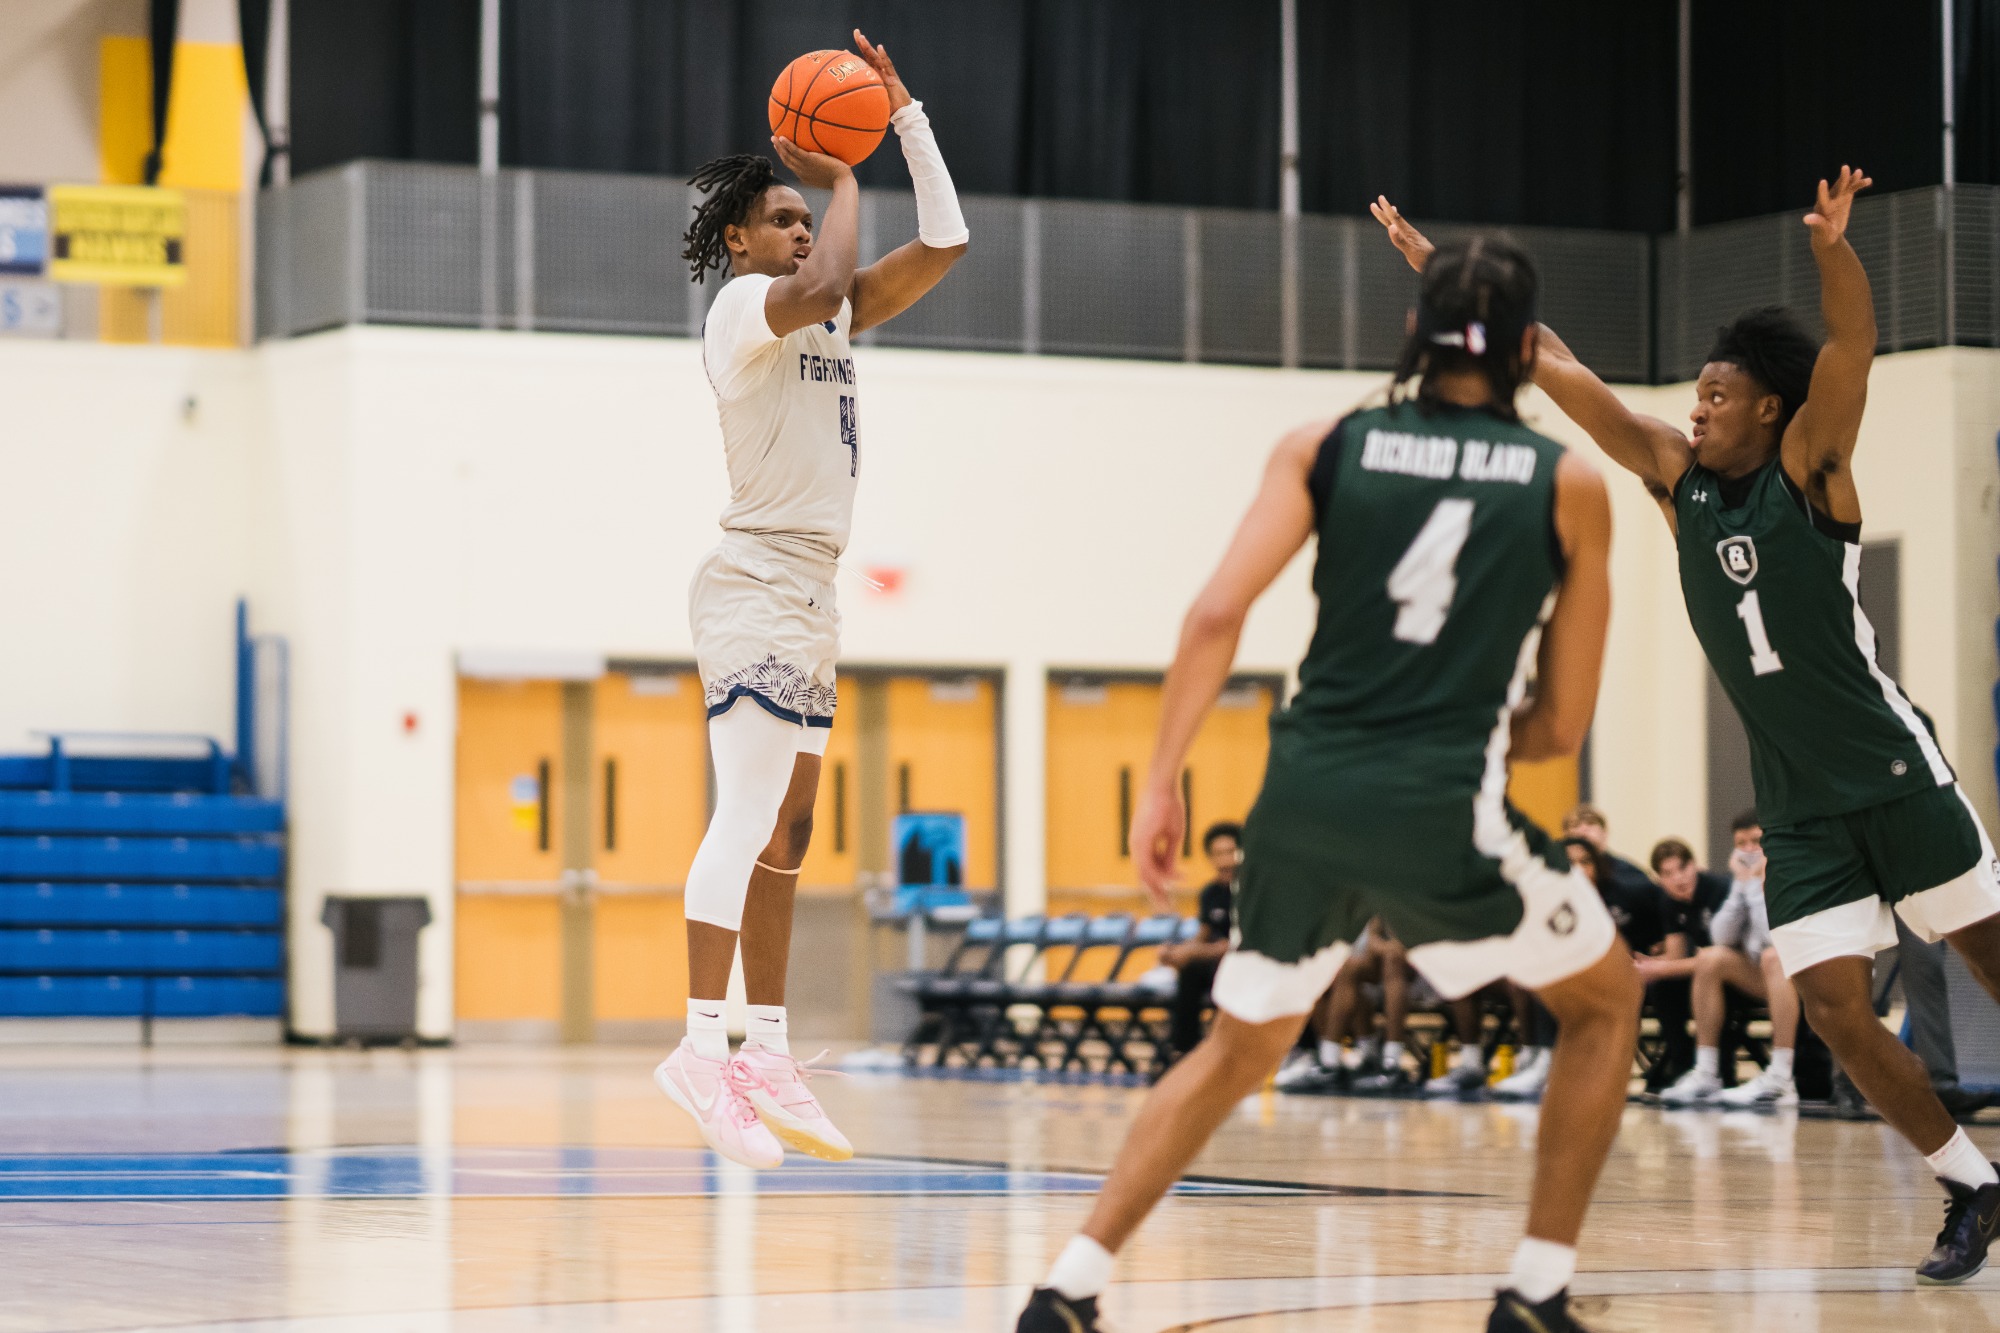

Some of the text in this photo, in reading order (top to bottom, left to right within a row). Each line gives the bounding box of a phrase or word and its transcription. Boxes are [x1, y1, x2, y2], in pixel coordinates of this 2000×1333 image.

[840, 395, 857, 477] 4
[1385, 498, 1475, 644] 4
[1736, 589, 1784, 676] 1
